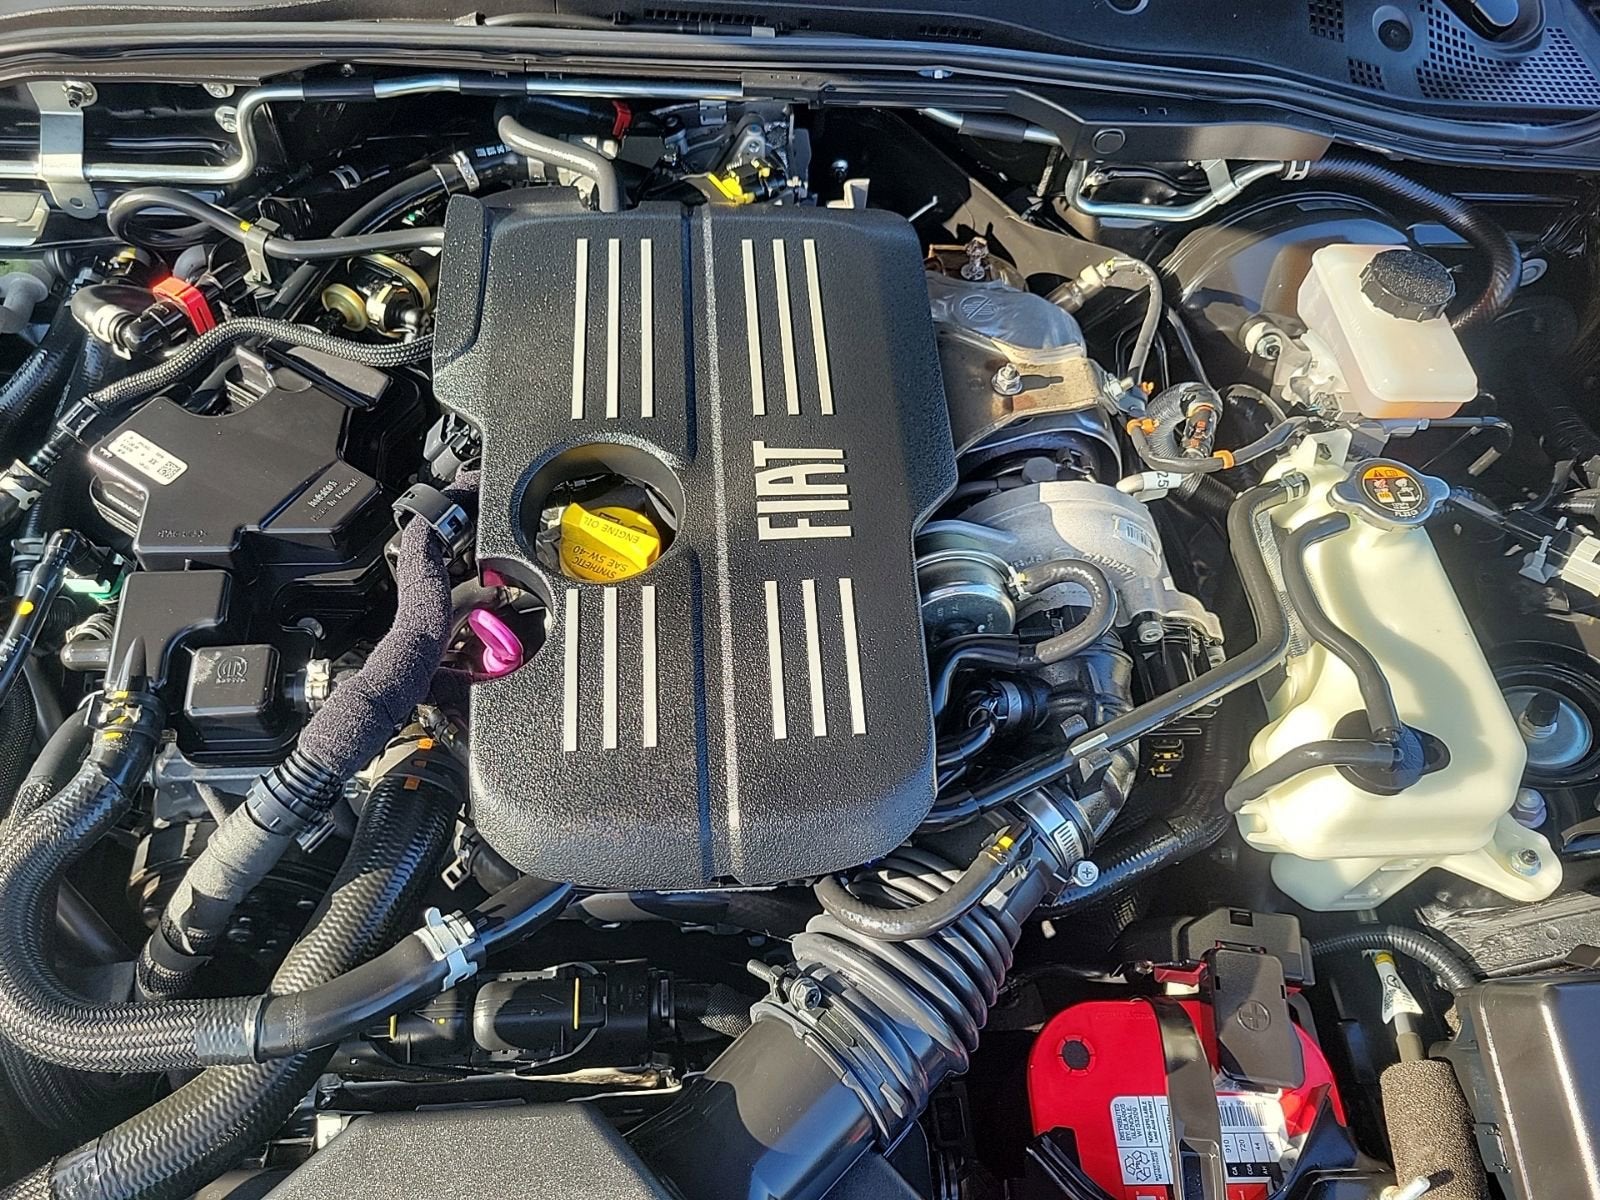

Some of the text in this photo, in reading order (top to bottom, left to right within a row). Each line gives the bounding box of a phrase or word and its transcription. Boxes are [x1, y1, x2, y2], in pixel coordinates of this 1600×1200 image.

[753, 440, 852, 540] FIAT
[1157, 471, 1169, 488] 25
[583, 516, 640, 544] ENGINE OIL
[572, 556, 617, 579] SYNTHETIC
[573, 545, 629, 573] SAE 5W-40
[1114, 1103, 1126, 1141] DISTRIBUTED
[1120, 1103, 1130, 1131] CLARIOS
[1142, 1100, 1153, 1143] NON-SPILLABLE
[1223, 1139, 1232, 1153] 910
[1238, 1139, 1247, 1153] 720
[1254, 1142, 1261, 1151] 44
[1231, 1166, 1239, 1176] CA
[1246, 1163, 1254, 1176] CCA
